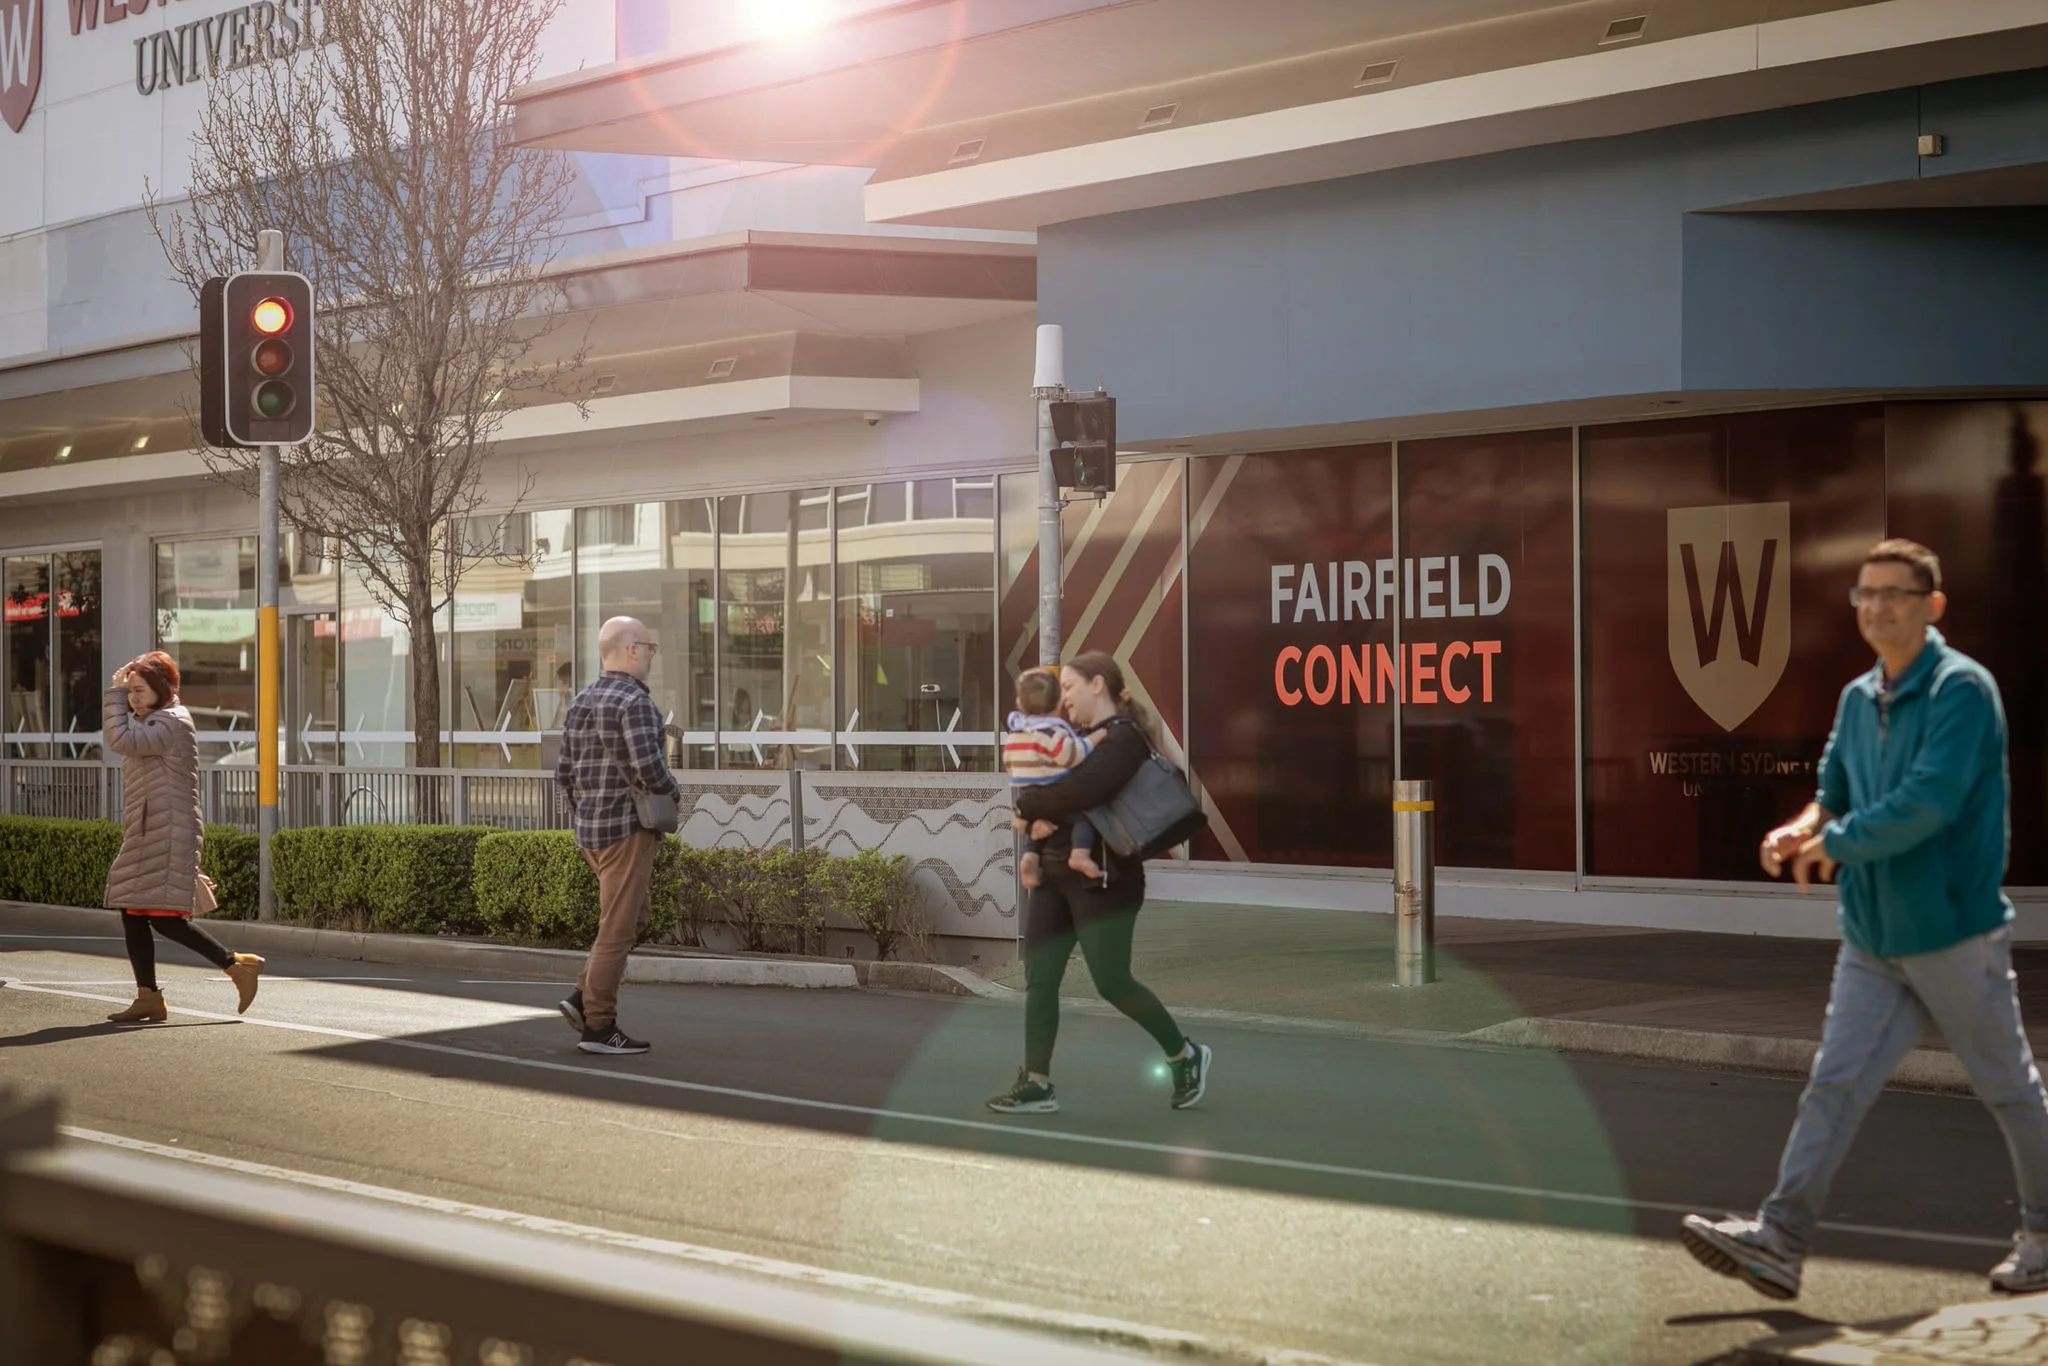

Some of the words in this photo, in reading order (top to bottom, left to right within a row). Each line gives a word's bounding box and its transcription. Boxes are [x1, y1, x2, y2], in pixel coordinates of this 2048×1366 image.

[1271, 553, 1511, 623] FAIRFIELD
[1680, 539, 1777, 668] W
[1274, 640, 1502, 706] CONNECT
